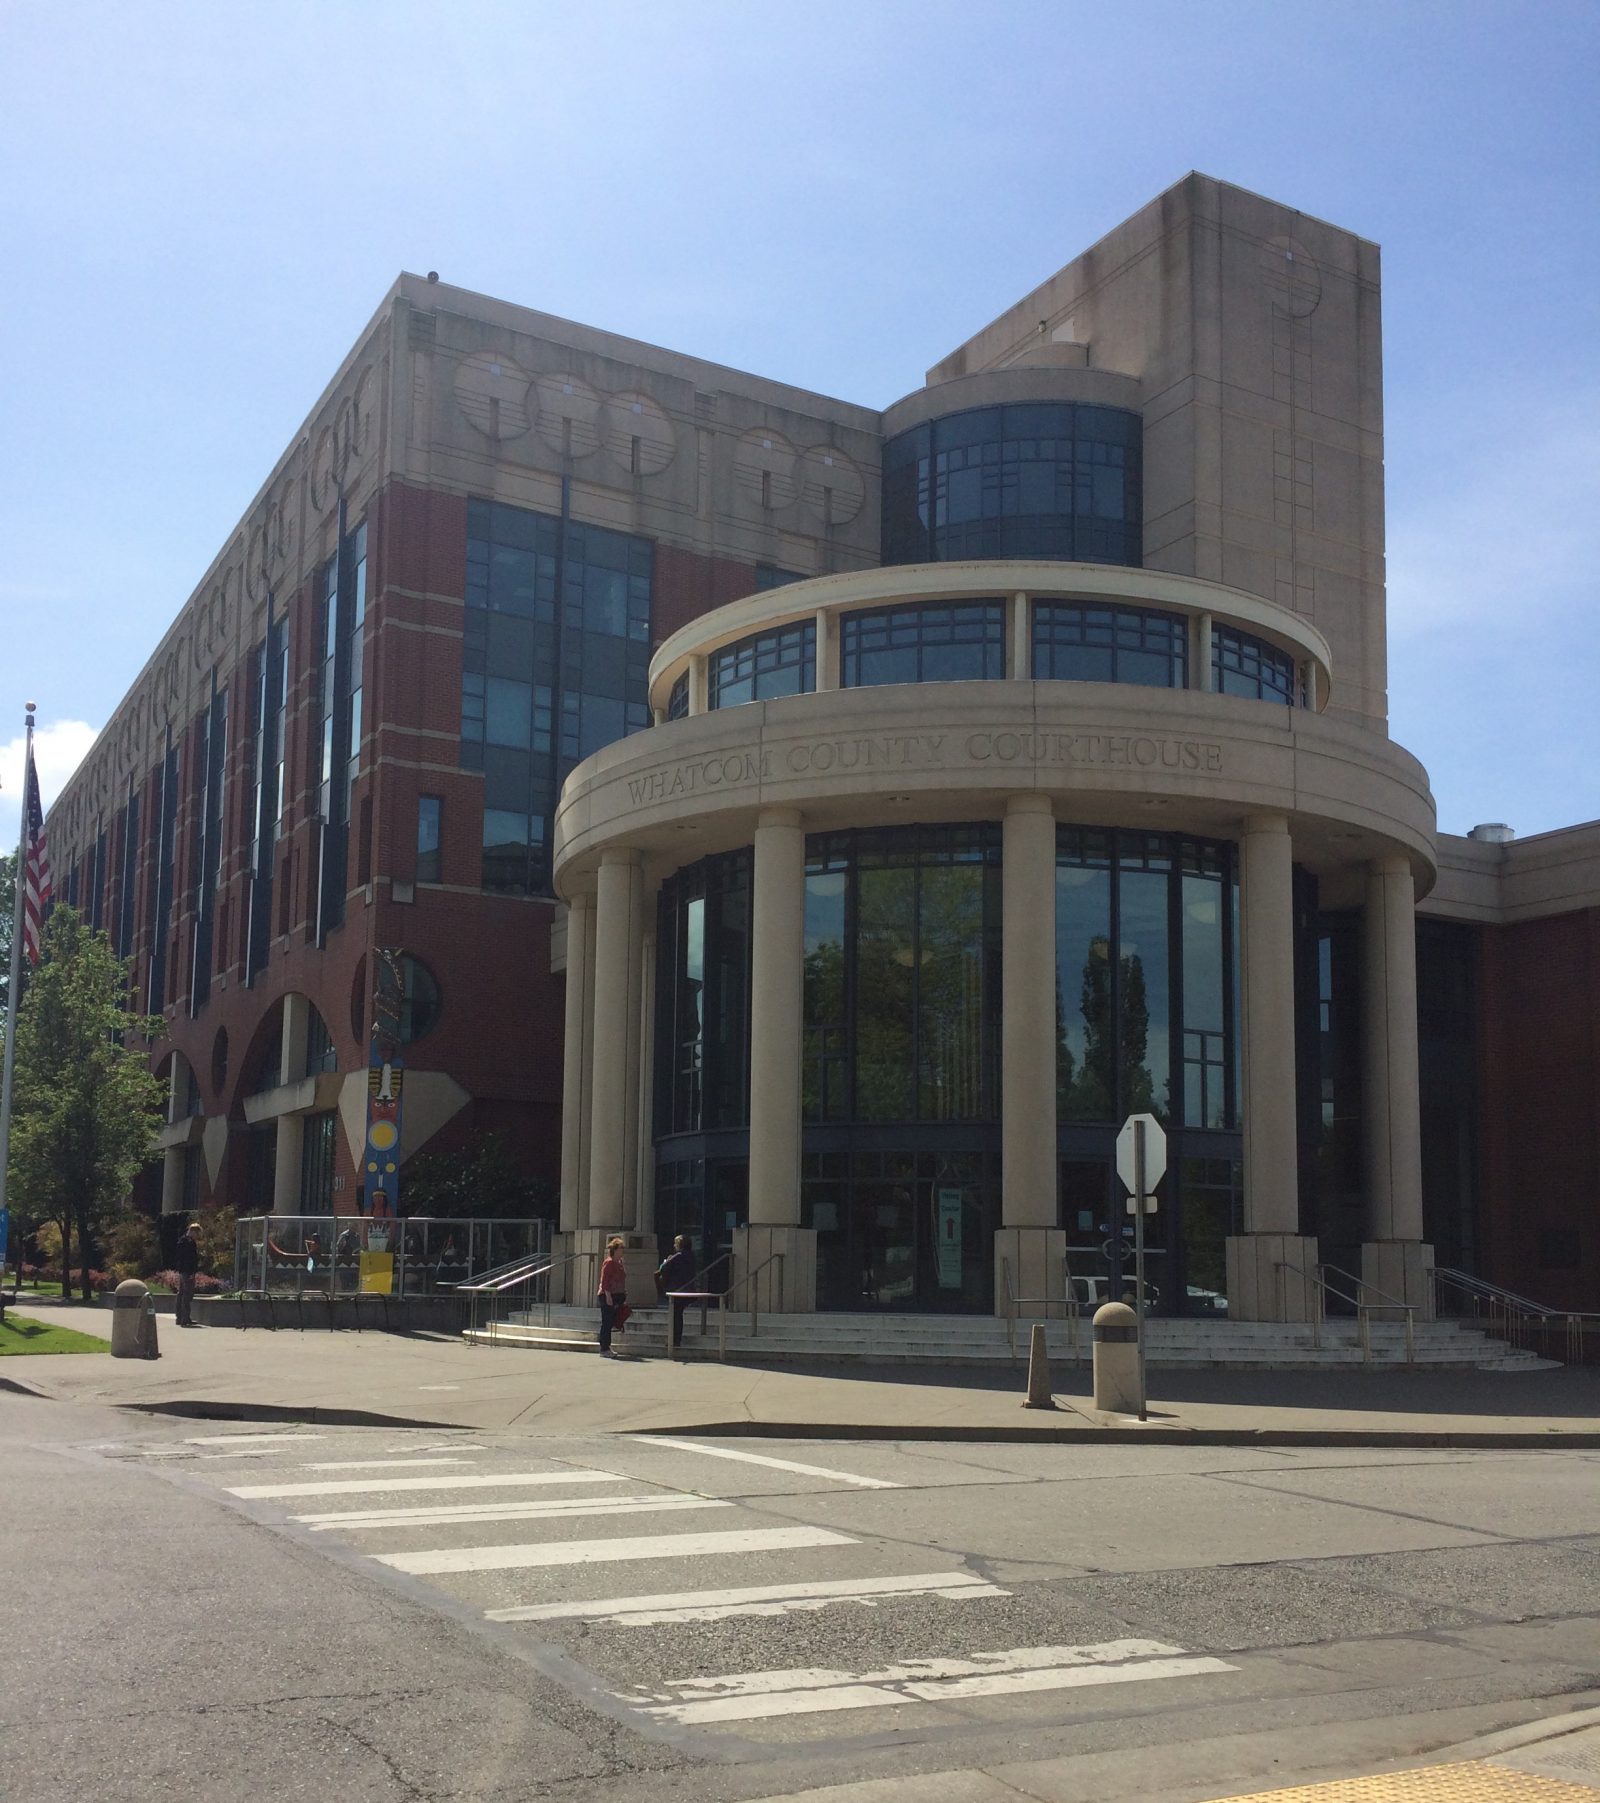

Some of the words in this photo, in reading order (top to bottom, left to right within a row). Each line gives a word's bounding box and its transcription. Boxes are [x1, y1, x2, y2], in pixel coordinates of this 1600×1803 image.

[627, 749, 773, 806] WHATCOM
[786, 735, 949, 773] COUNTY
[964, 732, 1222, 772] COURTHOUSE
